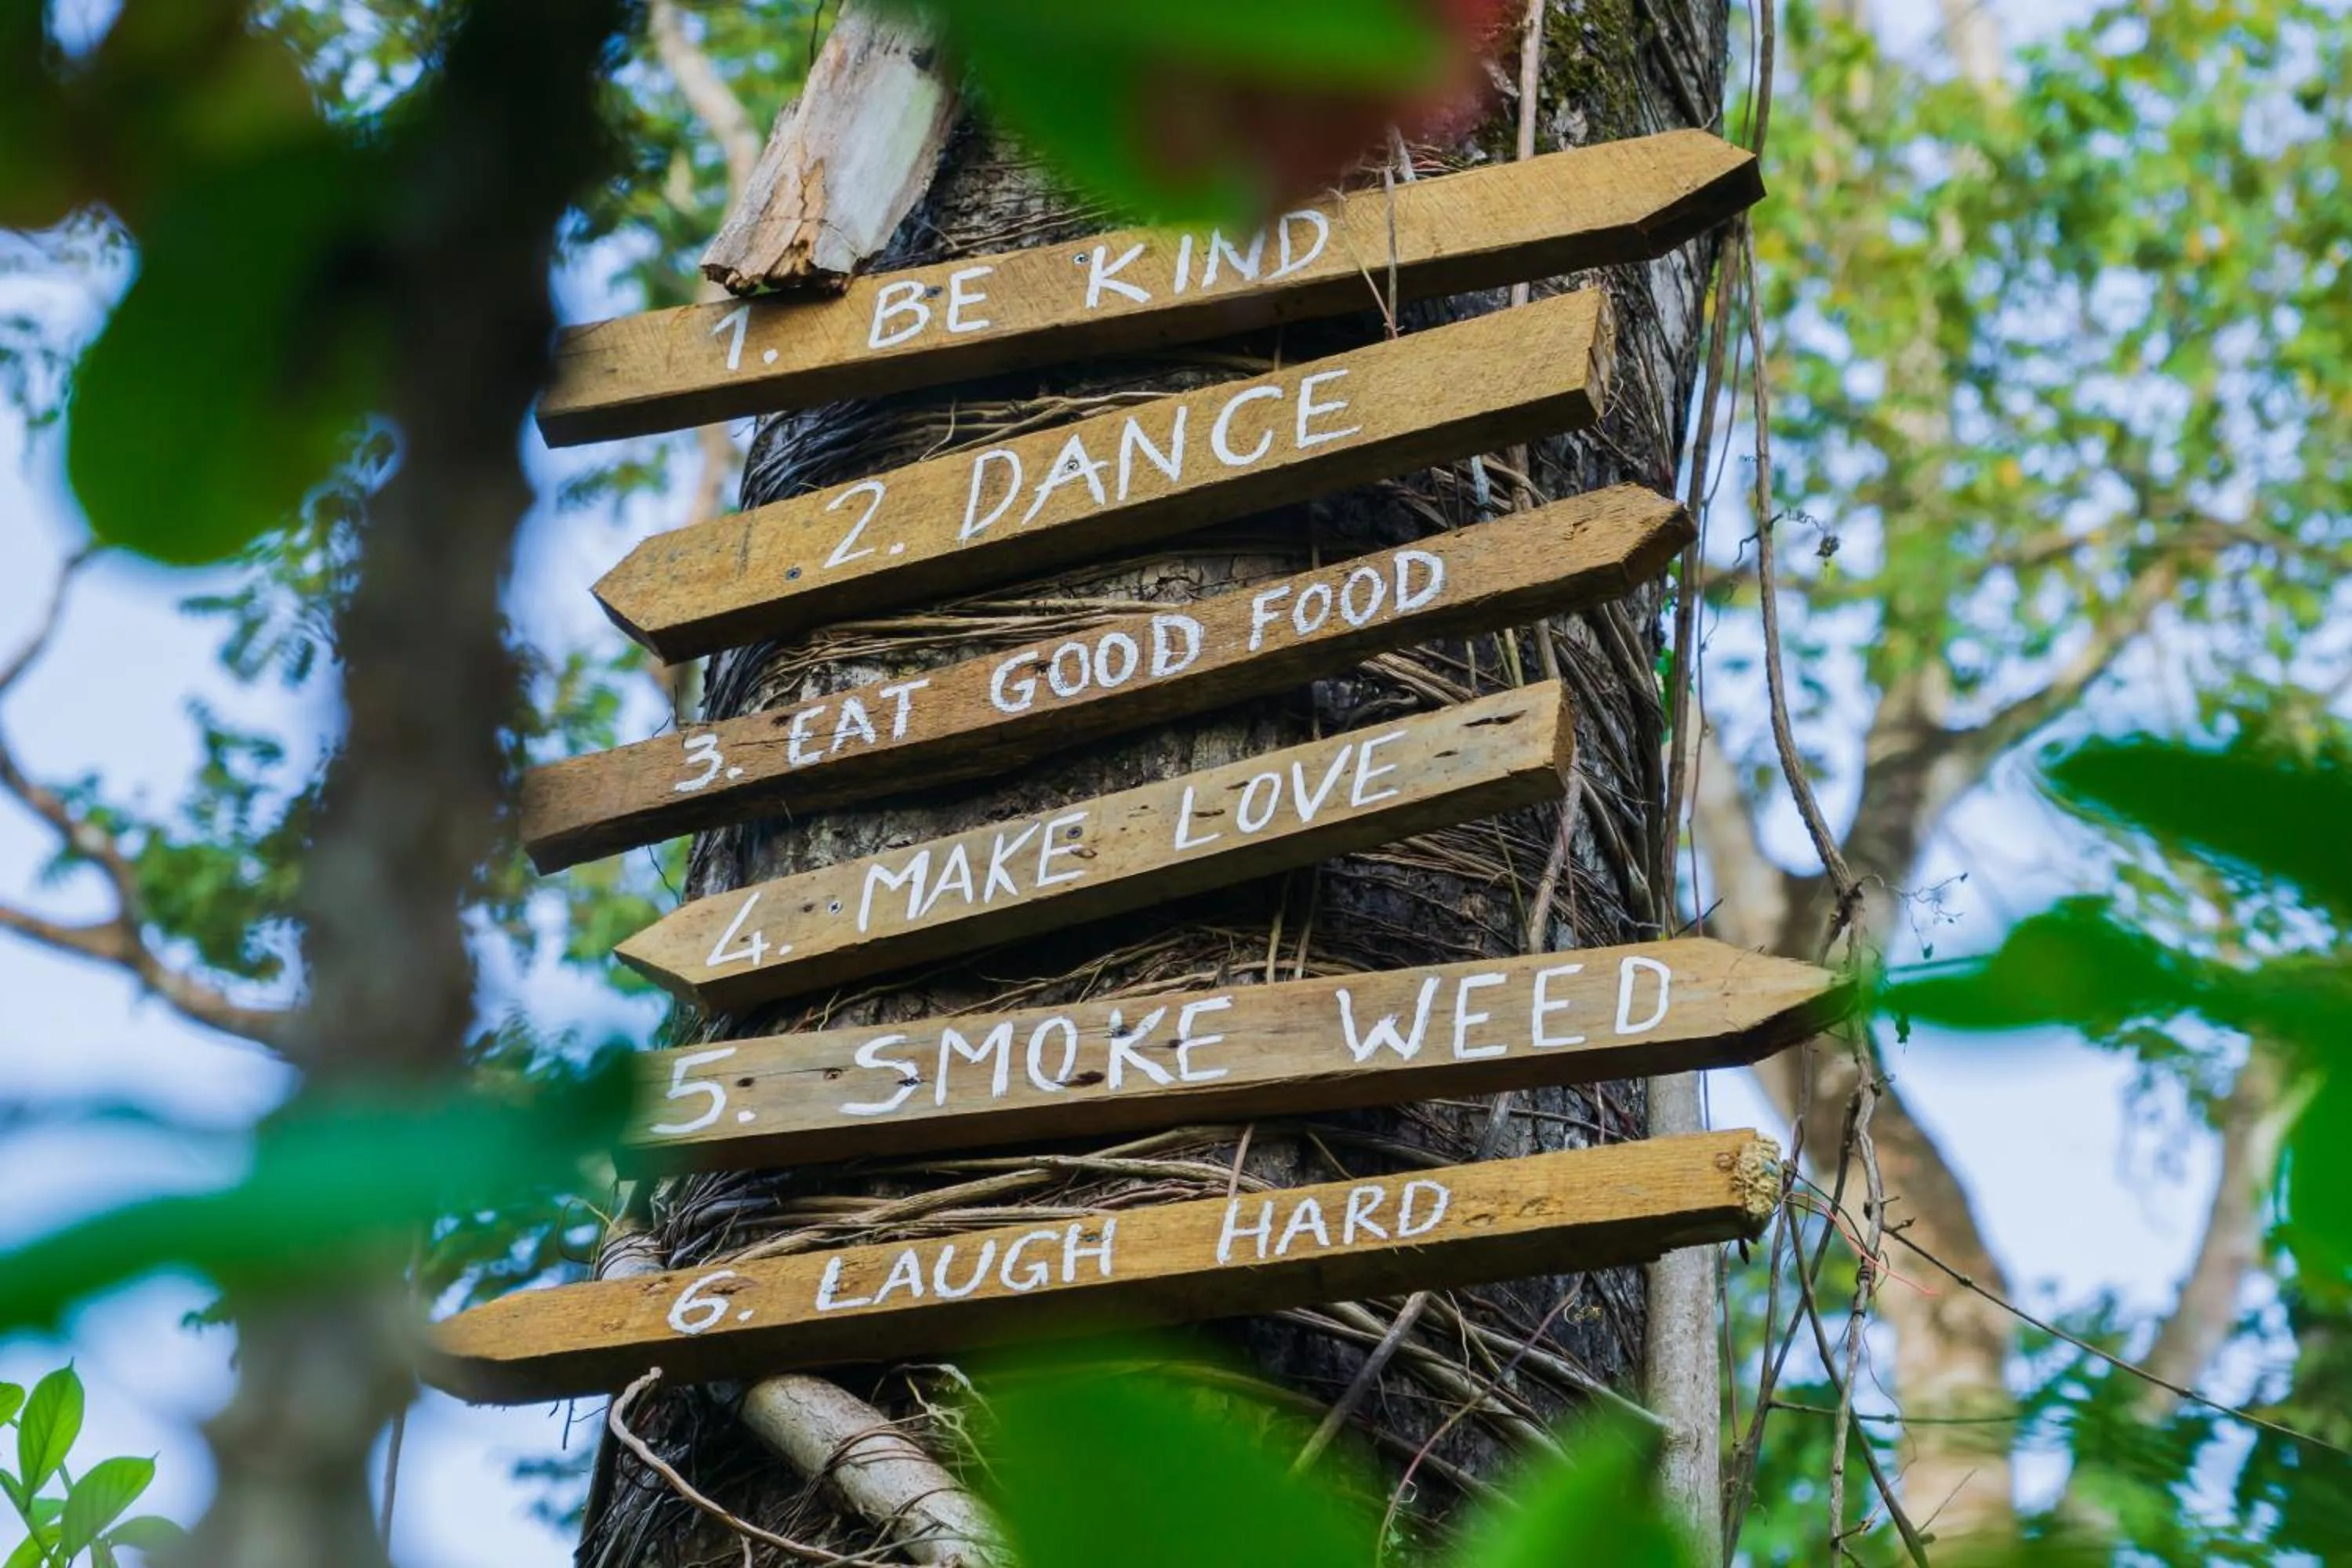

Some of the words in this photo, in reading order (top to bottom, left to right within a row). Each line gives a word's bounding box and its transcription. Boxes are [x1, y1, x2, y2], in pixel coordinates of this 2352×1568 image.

[710, 304, 779, 369] 1.
[868, 266, 994, 349] BE
[1085, 209, 1329, 308] KIND
[823, 481, 905, 569] 2.
[958, 369, 1362, 543] DANCE
[674, 733, 744, 793] 3.
[786, 678, 930, 767] EAT
[991, 615, 1204, 713] GOOD
[1248, 550, 1446, 650] FOOD
[706, 892, 793, 967] 4.
[858, 811, 1088, 933] MAKE
[1174, 730, 1407, 851] LOVE
[649, 1047, 756, 1134] 5.
[839, 996, 1234, 1116] SMOKE
[1335, 956, 1671, 1064] WEED
[667, 1270, 754, 1335] 6.
[816, 1218, 1118, 1312] LAUGH
[1216, 1180, 1450, 1265] HARD
